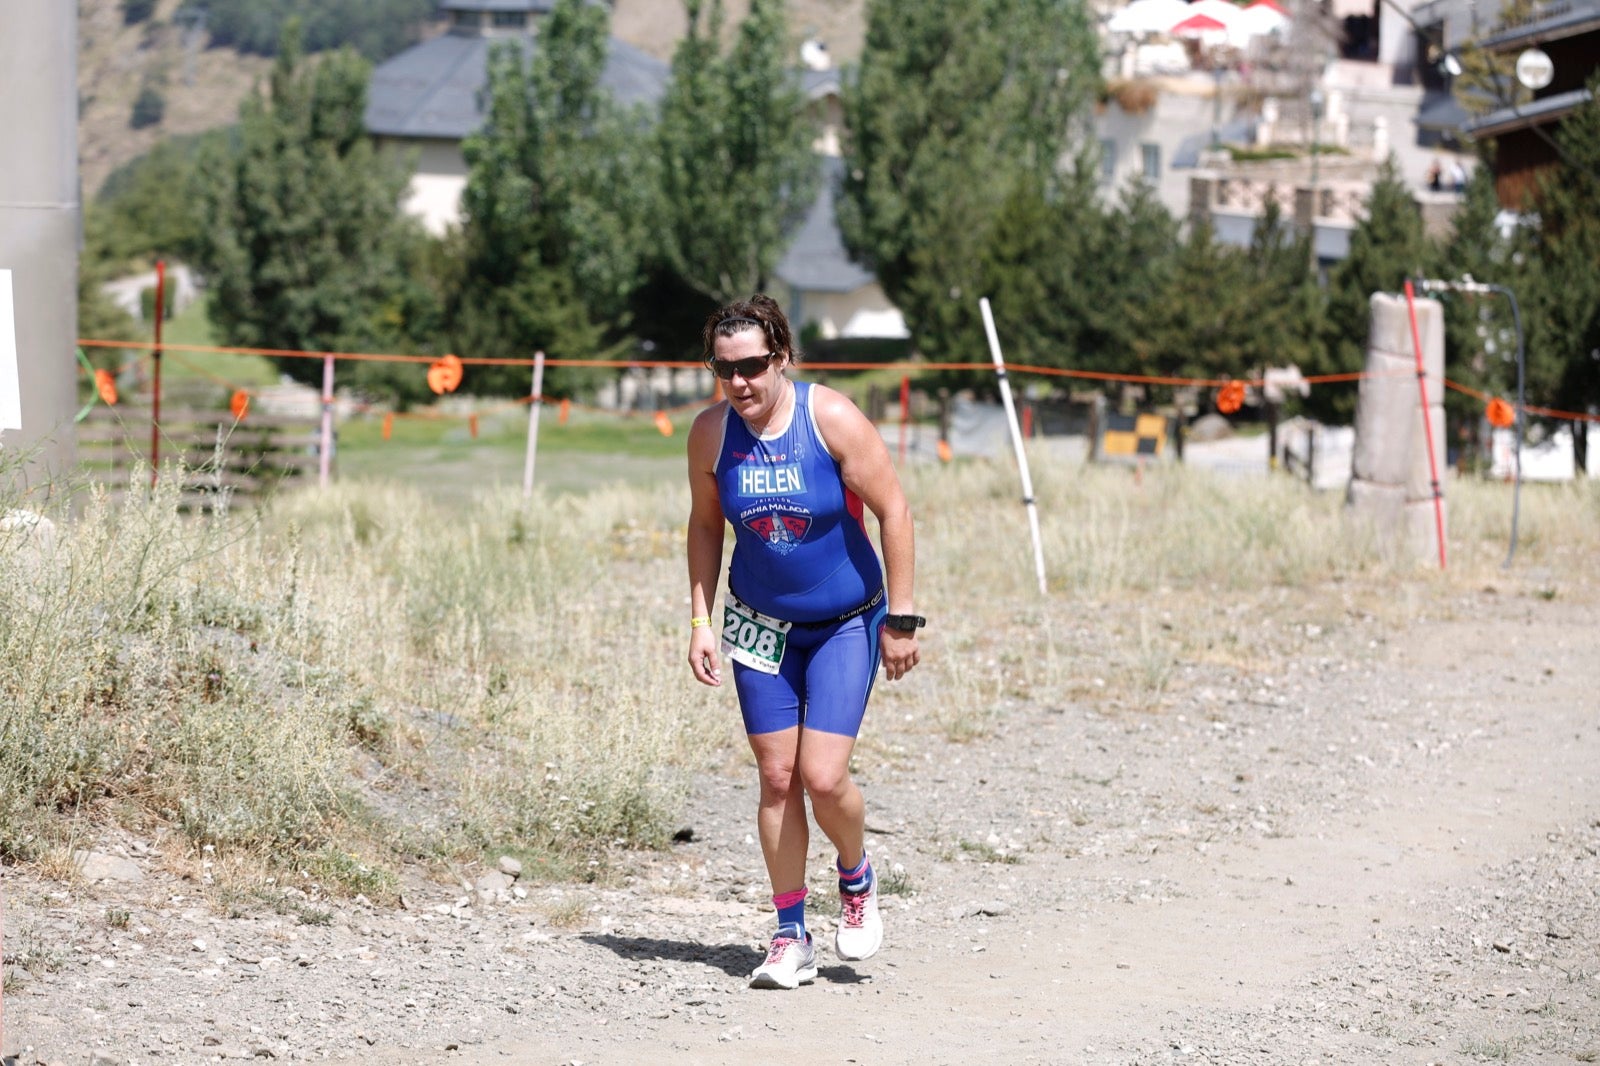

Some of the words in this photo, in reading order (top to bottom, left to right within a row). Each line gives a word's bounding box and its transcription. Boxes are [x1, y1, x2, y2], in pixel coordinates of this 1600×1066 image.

[742, 467, 801, 493] HELEN
[740, 505, 768, 518] BAHIA
[723, 613, 777, 656] 208
